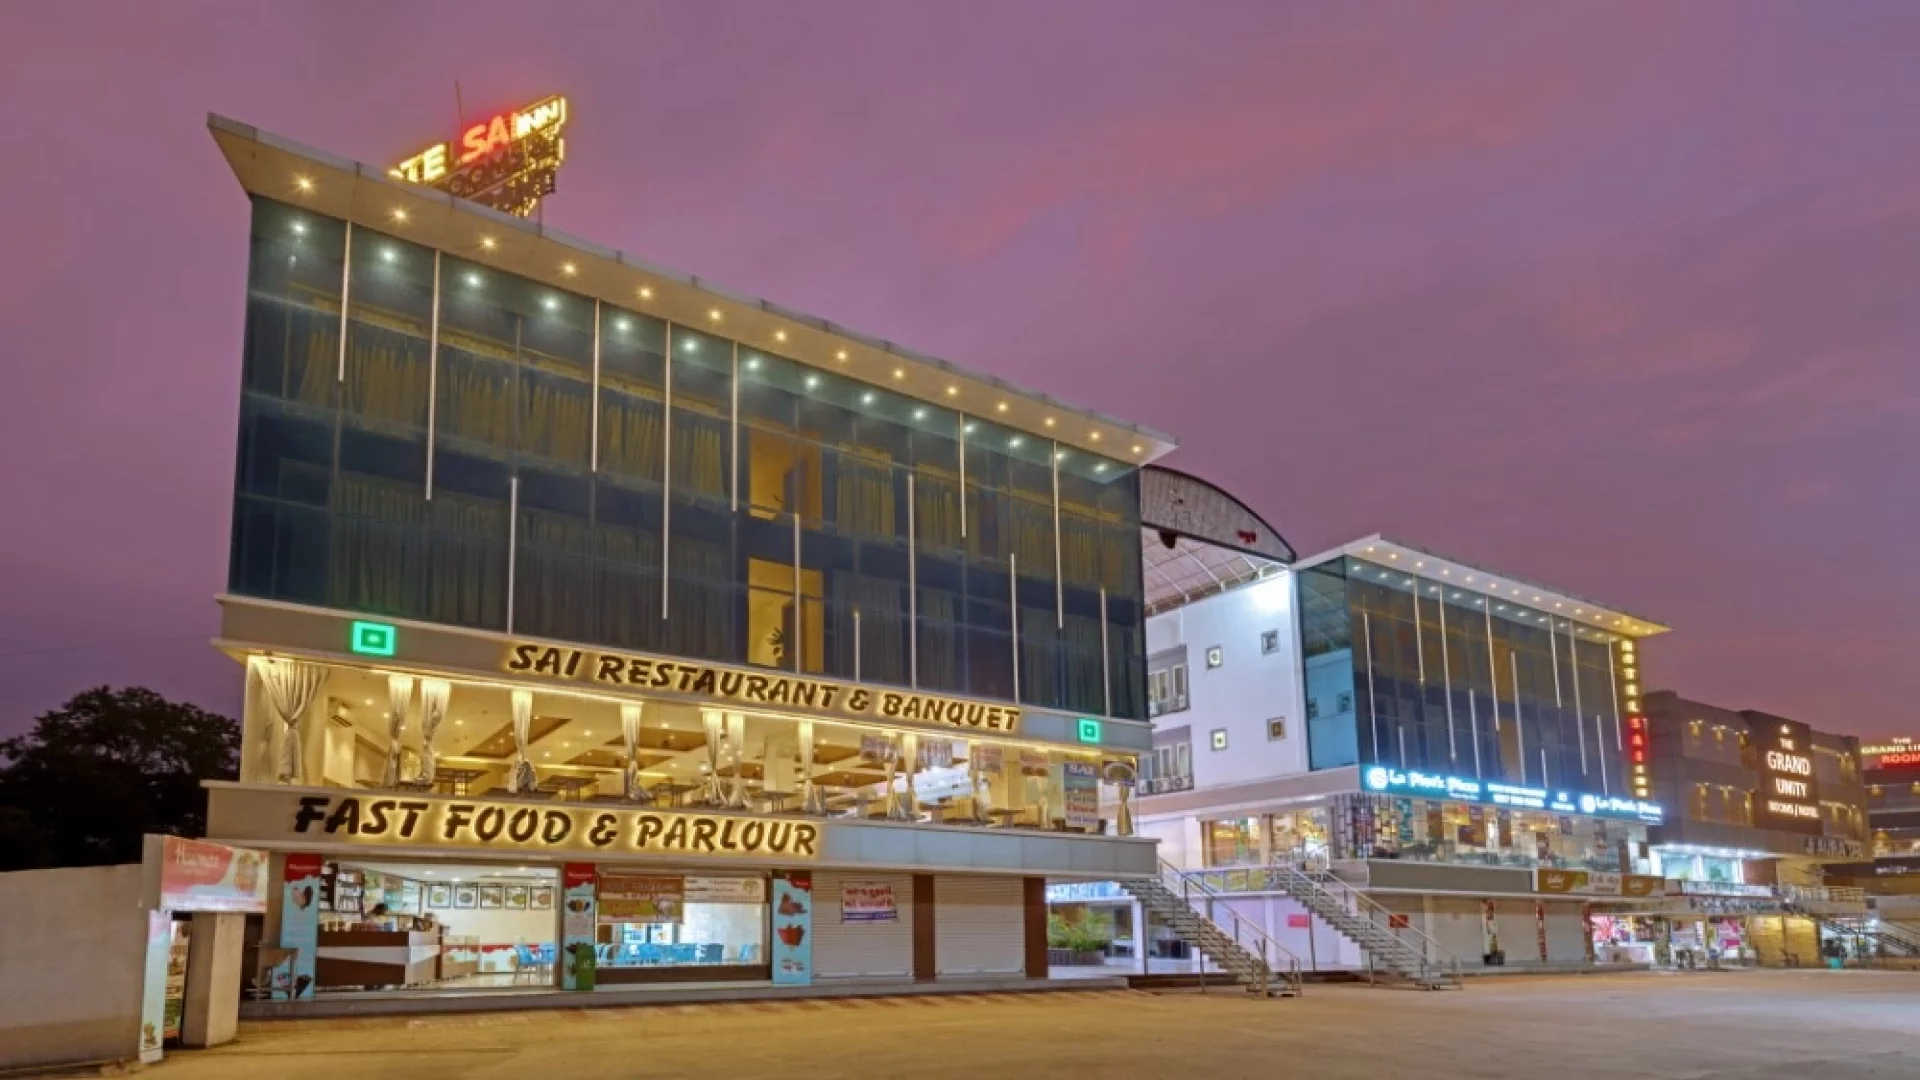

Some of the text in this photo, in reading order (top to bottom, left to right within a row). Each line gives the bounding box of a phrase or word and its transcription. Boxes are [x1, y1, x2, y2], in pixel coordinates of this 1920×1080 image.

[509, 644, 1020, 731] SAI RESTAURANT & BANQUET
[1767, 750, 1811, 776] GRAND
[1389, 769, 1406, 784] La
[1775, 778, 1807, 798] UNITY
[293, 797, 818, 856] FAST FOOD & PARLOUR
